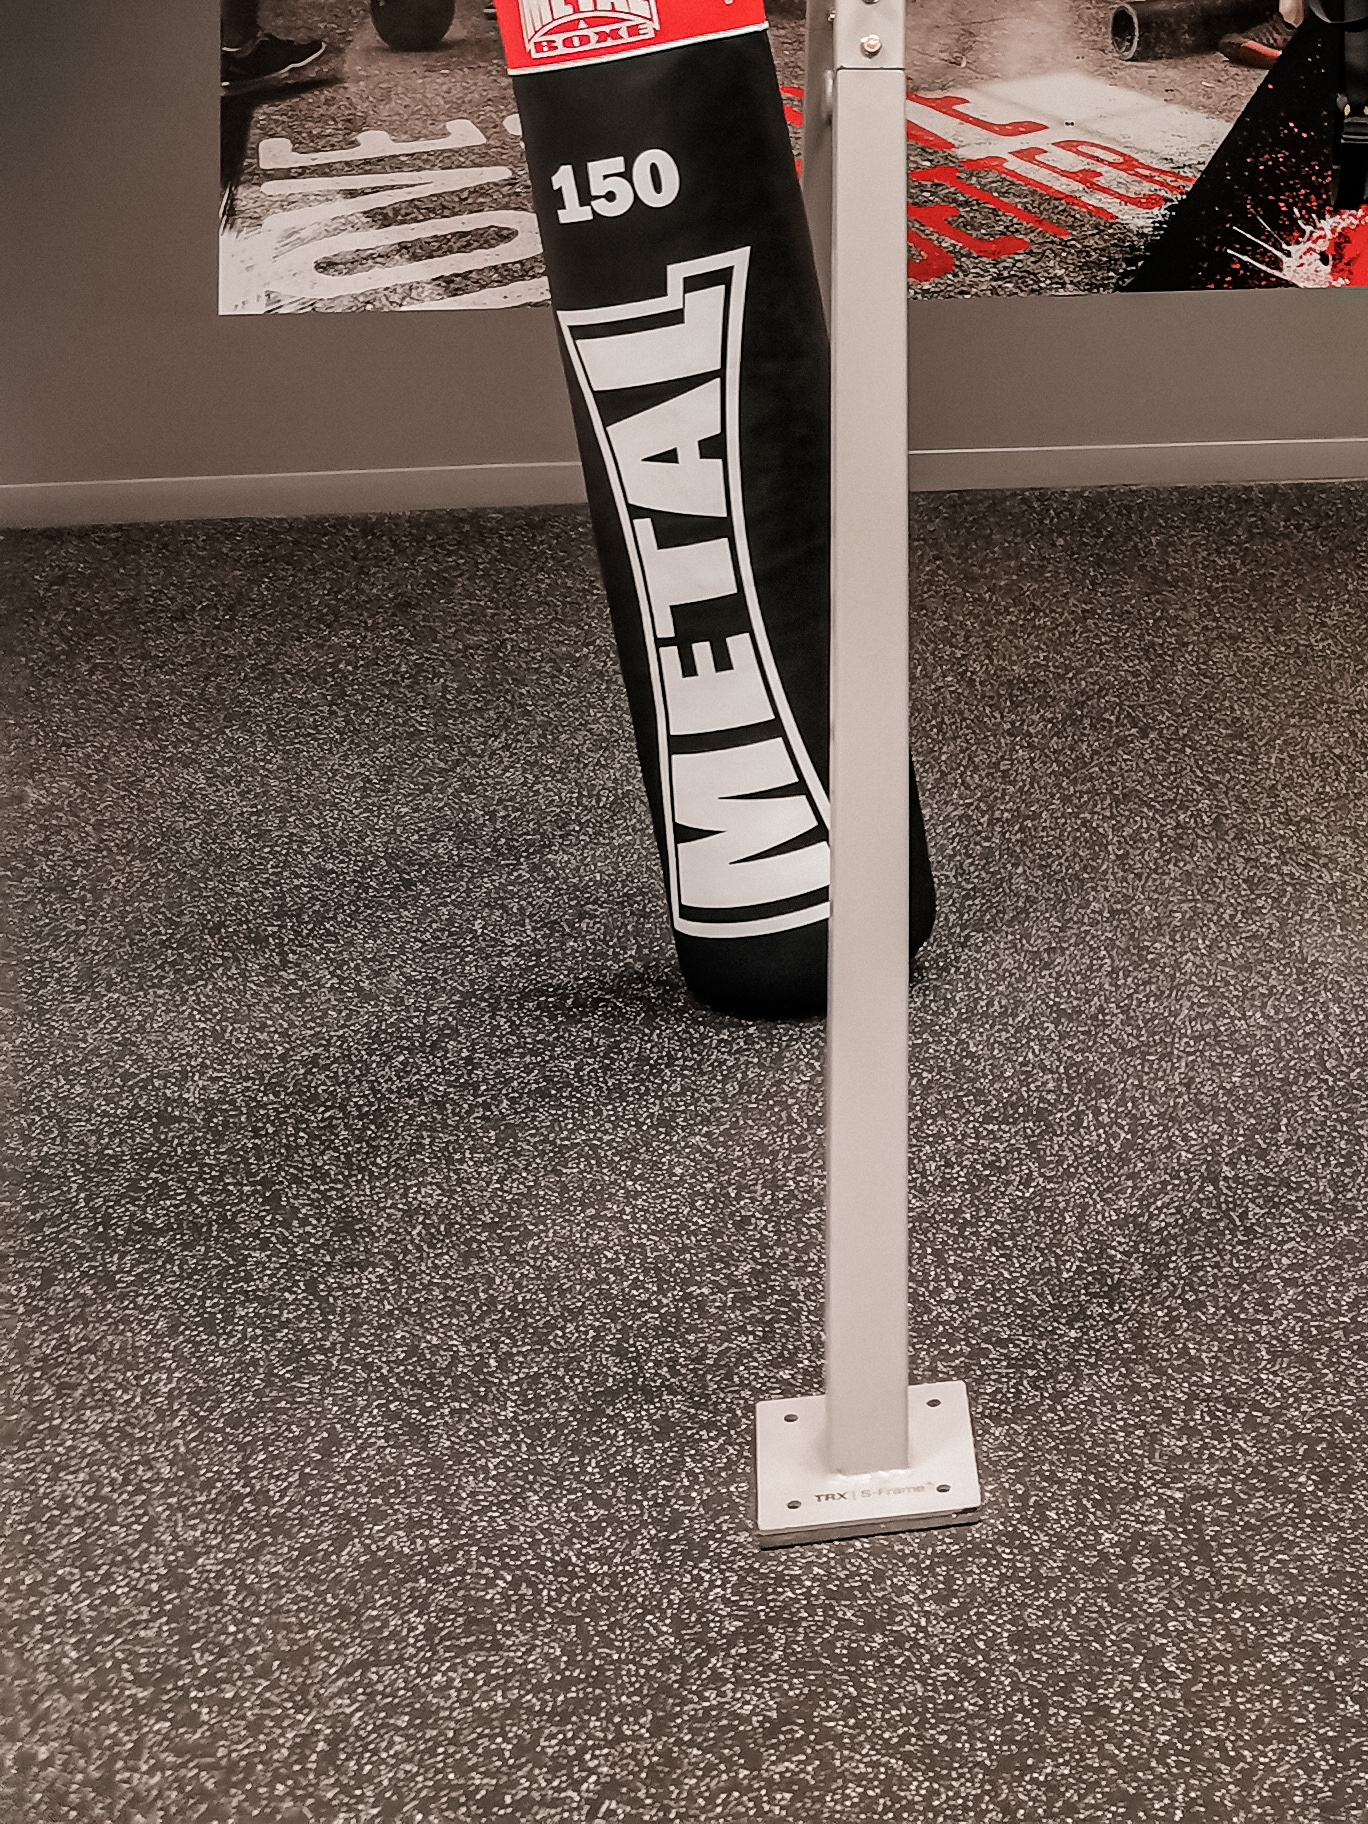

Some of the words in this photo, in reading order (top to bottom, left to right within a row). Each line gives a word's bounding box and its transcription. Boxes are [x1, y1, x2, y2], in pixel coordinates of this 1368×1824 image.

[533, 23, 653, 54] BOXE
[551, 148, 680, 224] 150
[573, 283, 829, 910] METAL
[814, 1491, 848, 1503] TRX
